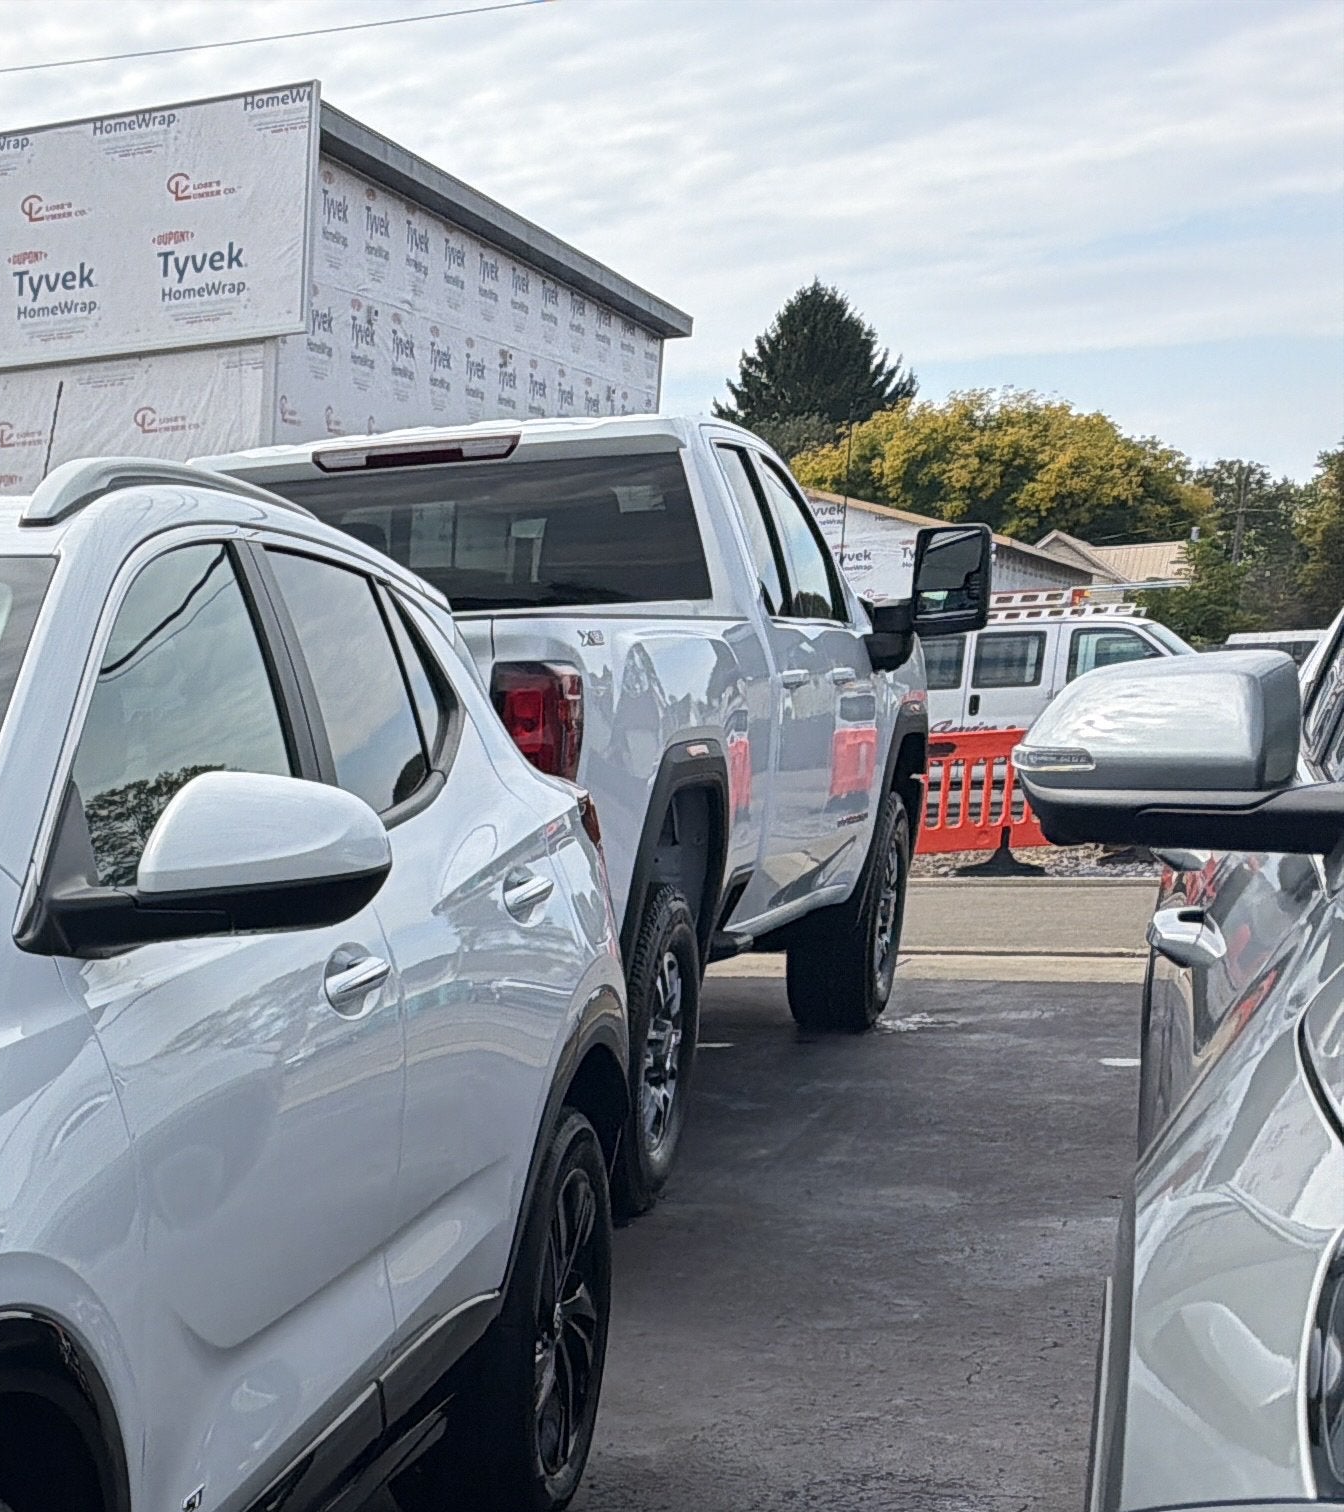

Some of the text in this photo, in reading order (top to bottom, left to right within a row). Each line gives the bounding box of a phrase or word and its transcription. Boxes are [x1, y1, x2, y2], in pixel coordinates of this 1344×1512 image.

[93, 111, 178, 136] HomeWrap
[322, 188, 348, 224] Tyvek
[156, 229, 191, 246] DUPONT
[365, 205, 390, 240] Tyvek
[407, 220, 429, 254] Tyvek
[157, 241, 243, 284] Tyvek
[445, 238, 466, 270] Tyvek
[479, 253, 499, 284] Tyvek
[12, 262, 94, 303] Tyvek
[160, 280, 246, 303] HomeWrap
[16, 300, 97, 322] HomeWrap
[312, 307, 333, 336] yvek
[392, 329, 415, 362] Tyvek
[465, 353, 485, 383] Tyvek
